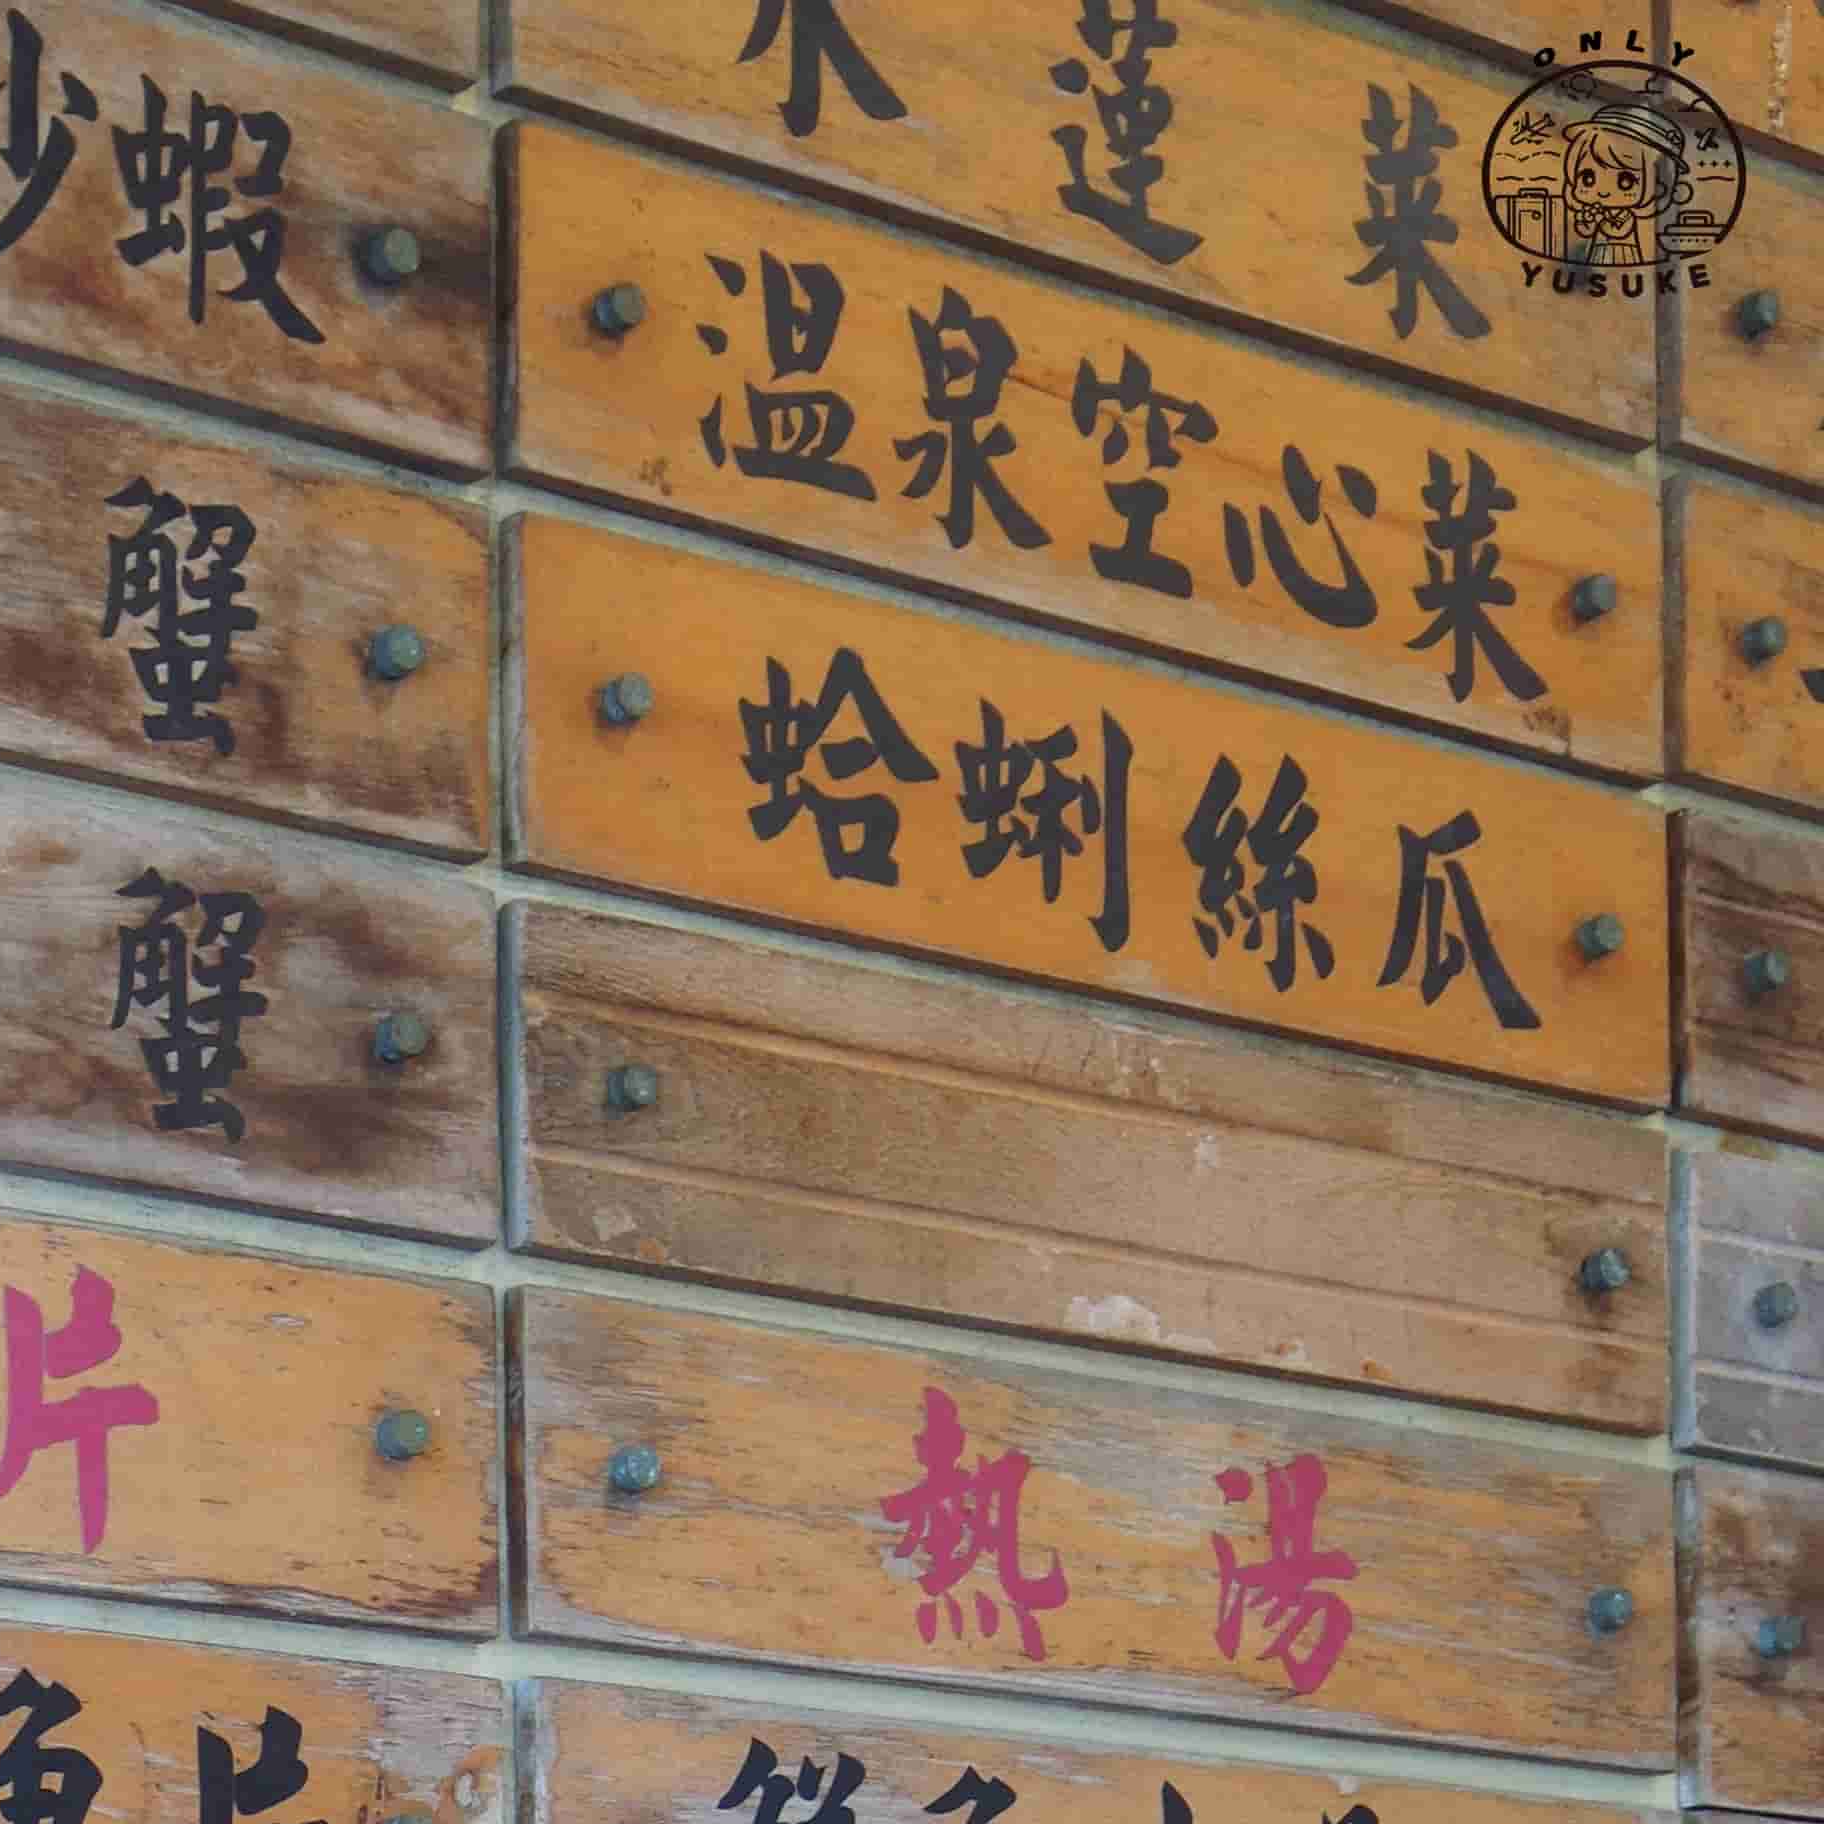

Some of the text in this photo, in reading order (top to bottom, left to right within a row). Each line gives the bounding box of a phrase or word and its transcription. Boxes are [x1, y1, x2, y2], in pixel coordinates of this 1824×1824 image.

[737, 648, 1543, 1032] 蛤蜊絲瓜
[882, 1385, 1357, 1697] 熱湯
